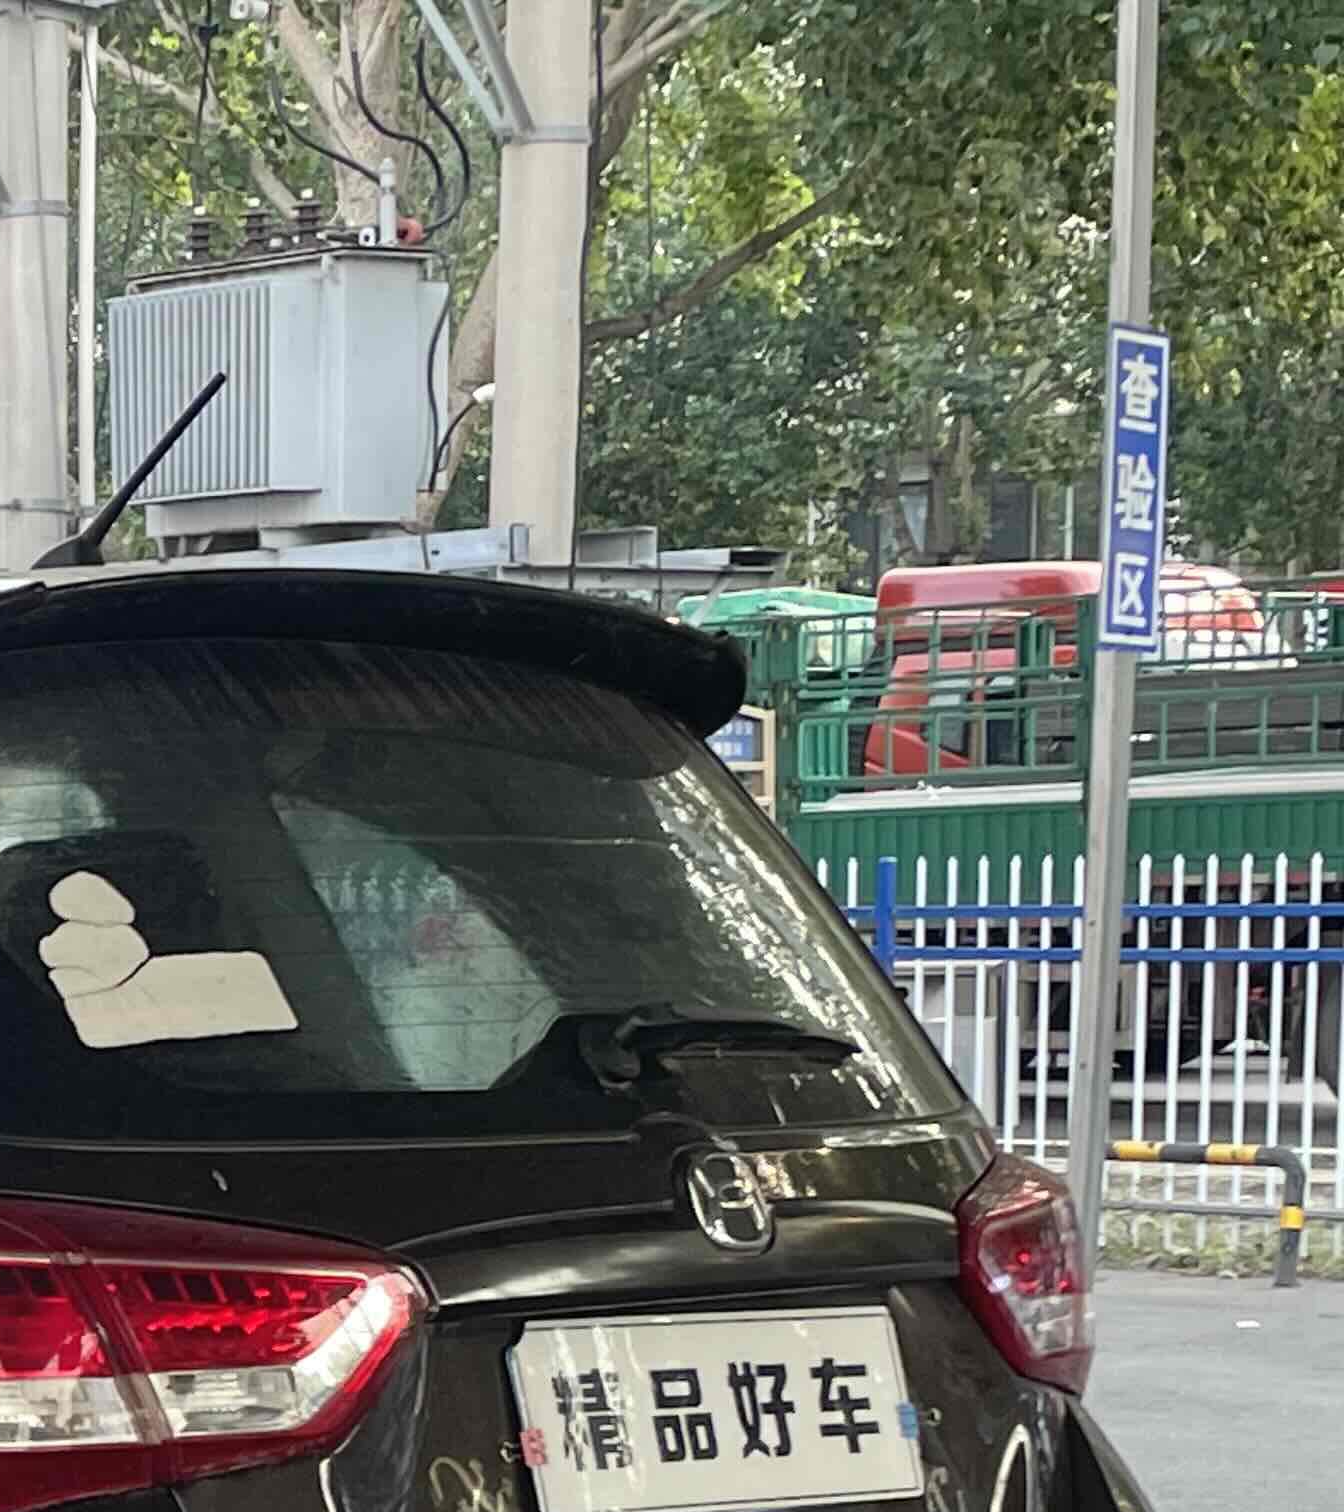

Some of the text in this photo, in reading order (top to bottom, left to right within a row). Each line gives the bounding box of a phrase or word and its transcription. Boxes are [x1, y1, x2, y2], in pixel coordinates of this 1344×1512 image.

[1114, 353, 1158, 627] 查验区
[551, 1357, 880, 1472] 精品好车
